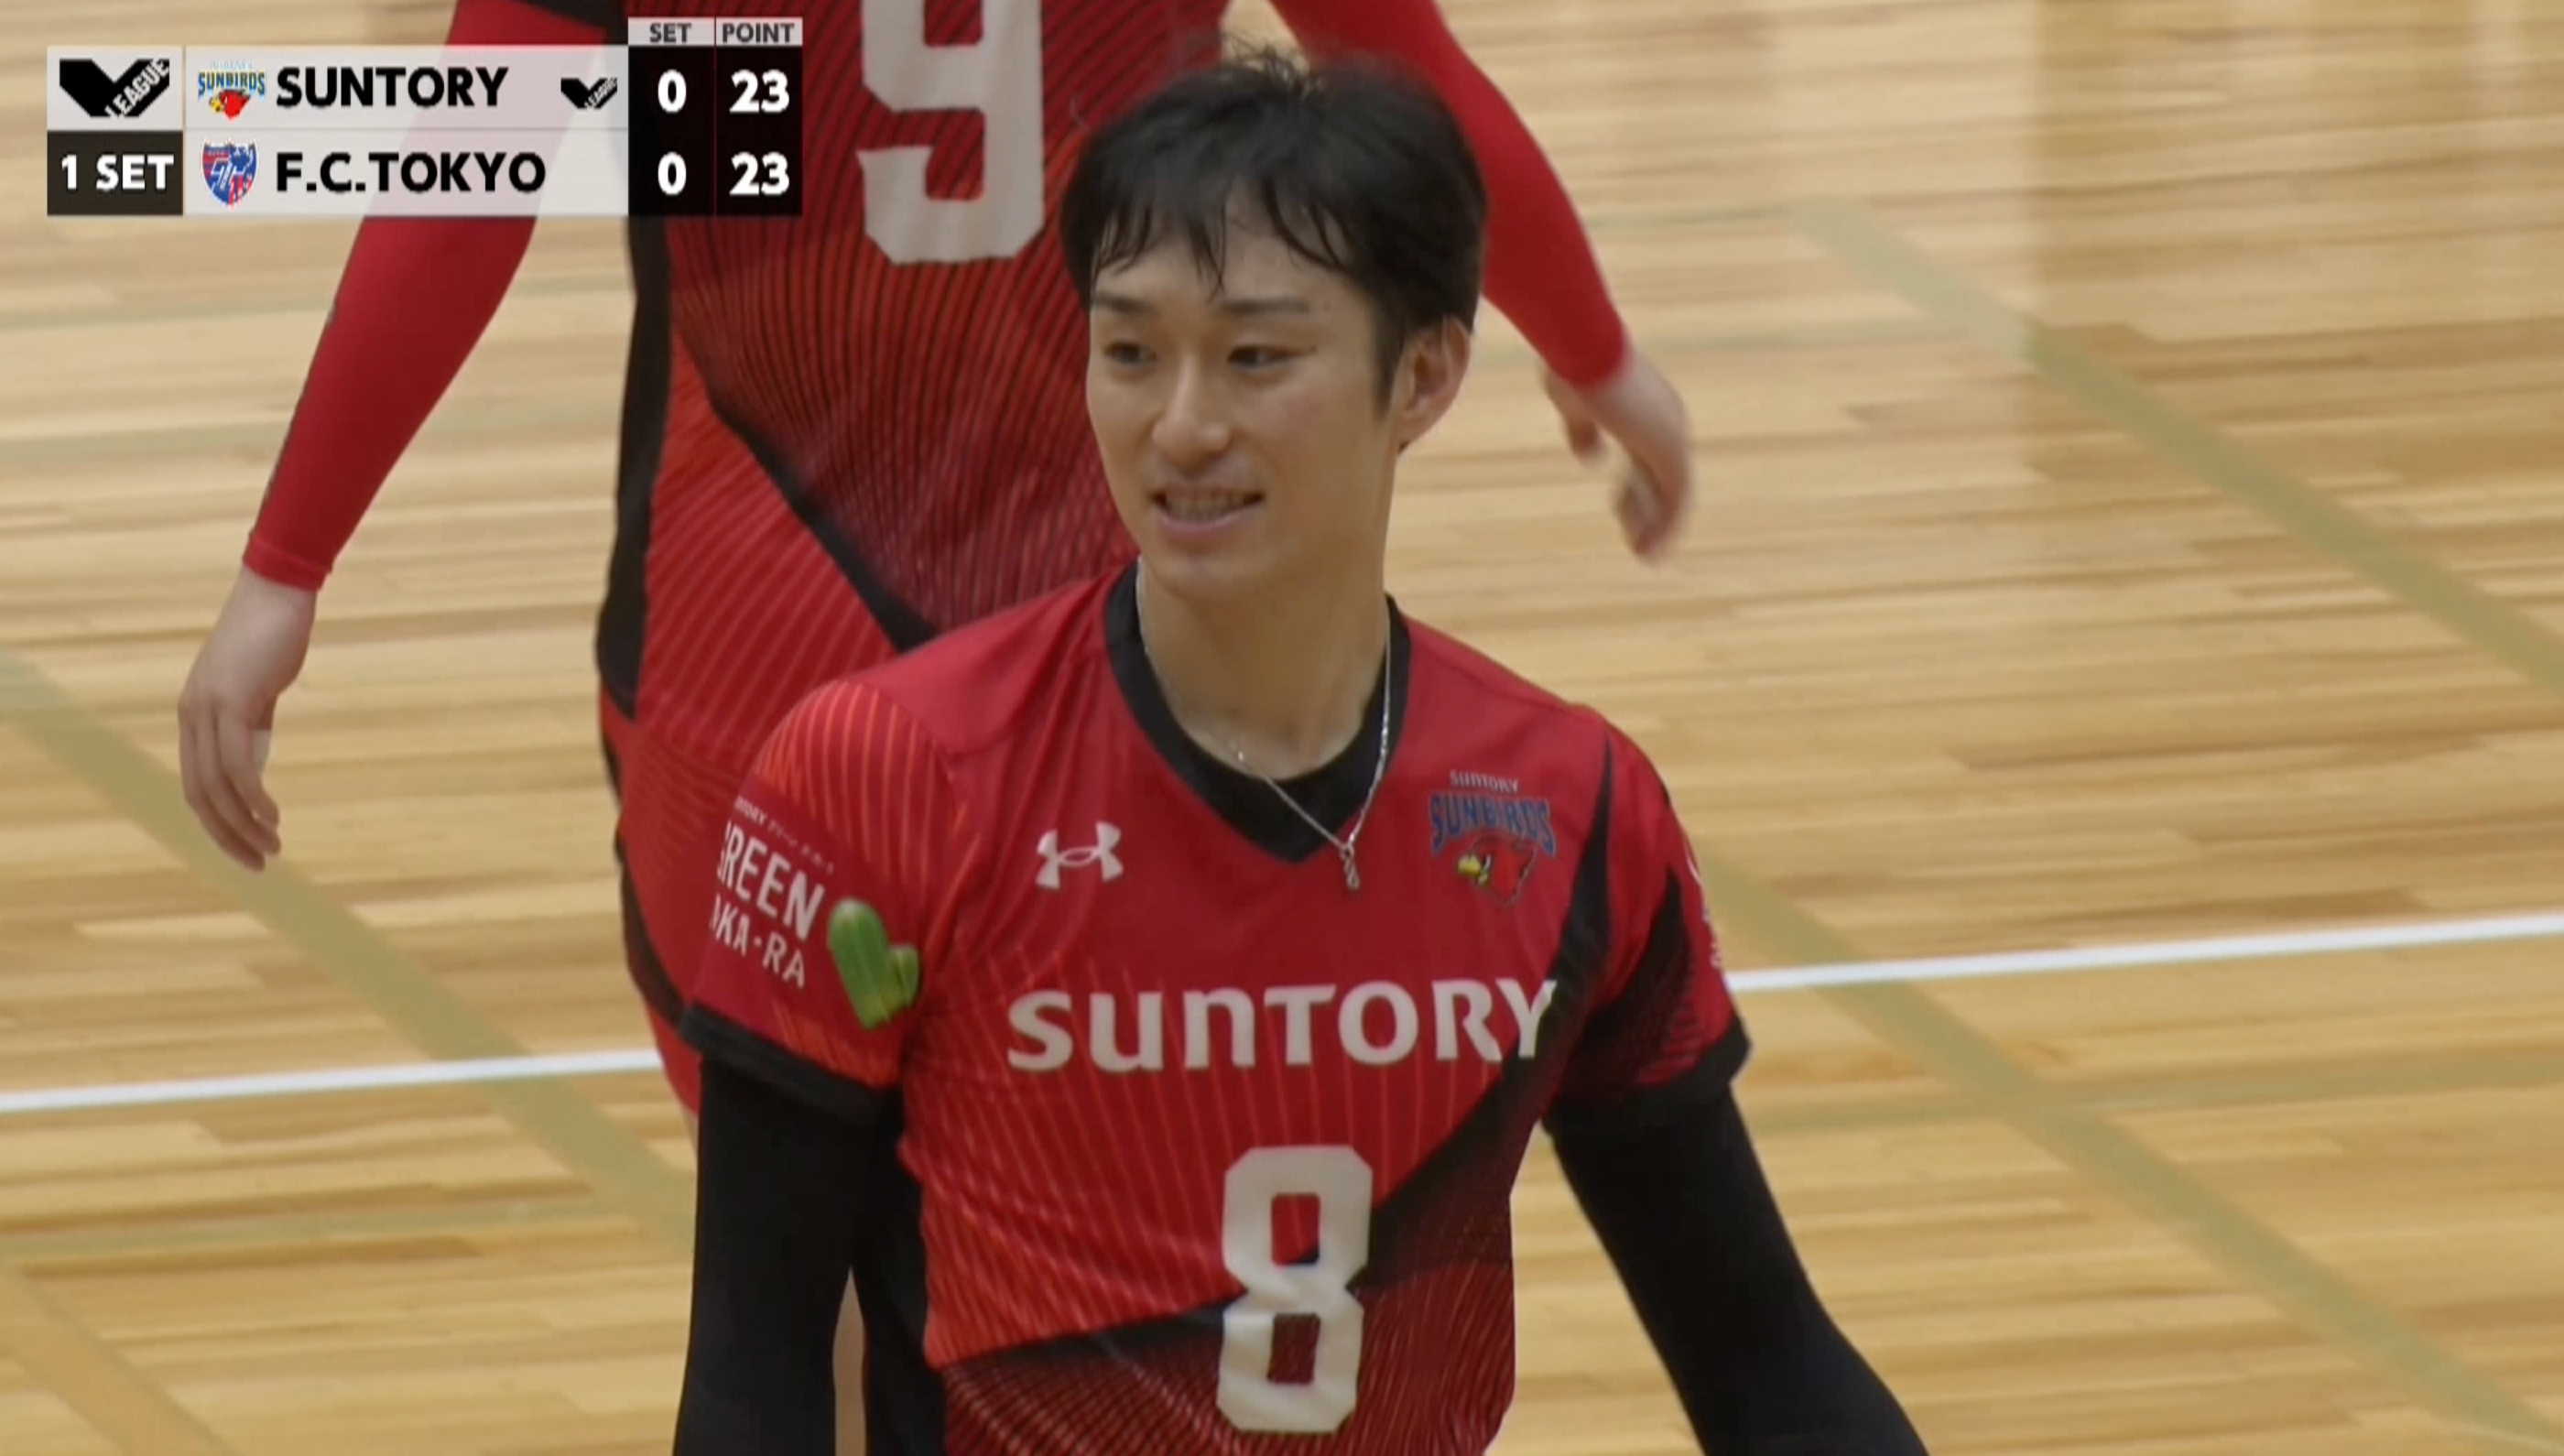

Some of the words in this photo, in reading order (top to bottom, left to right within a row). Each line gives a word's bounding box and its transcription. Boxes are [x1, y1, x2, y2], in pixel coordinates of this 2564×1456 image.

[856, 0, 1045, 266] 9
[1006, 978, 1558, 1072] SUNTORY
[1216, 1145, 1373, 1433] 8
